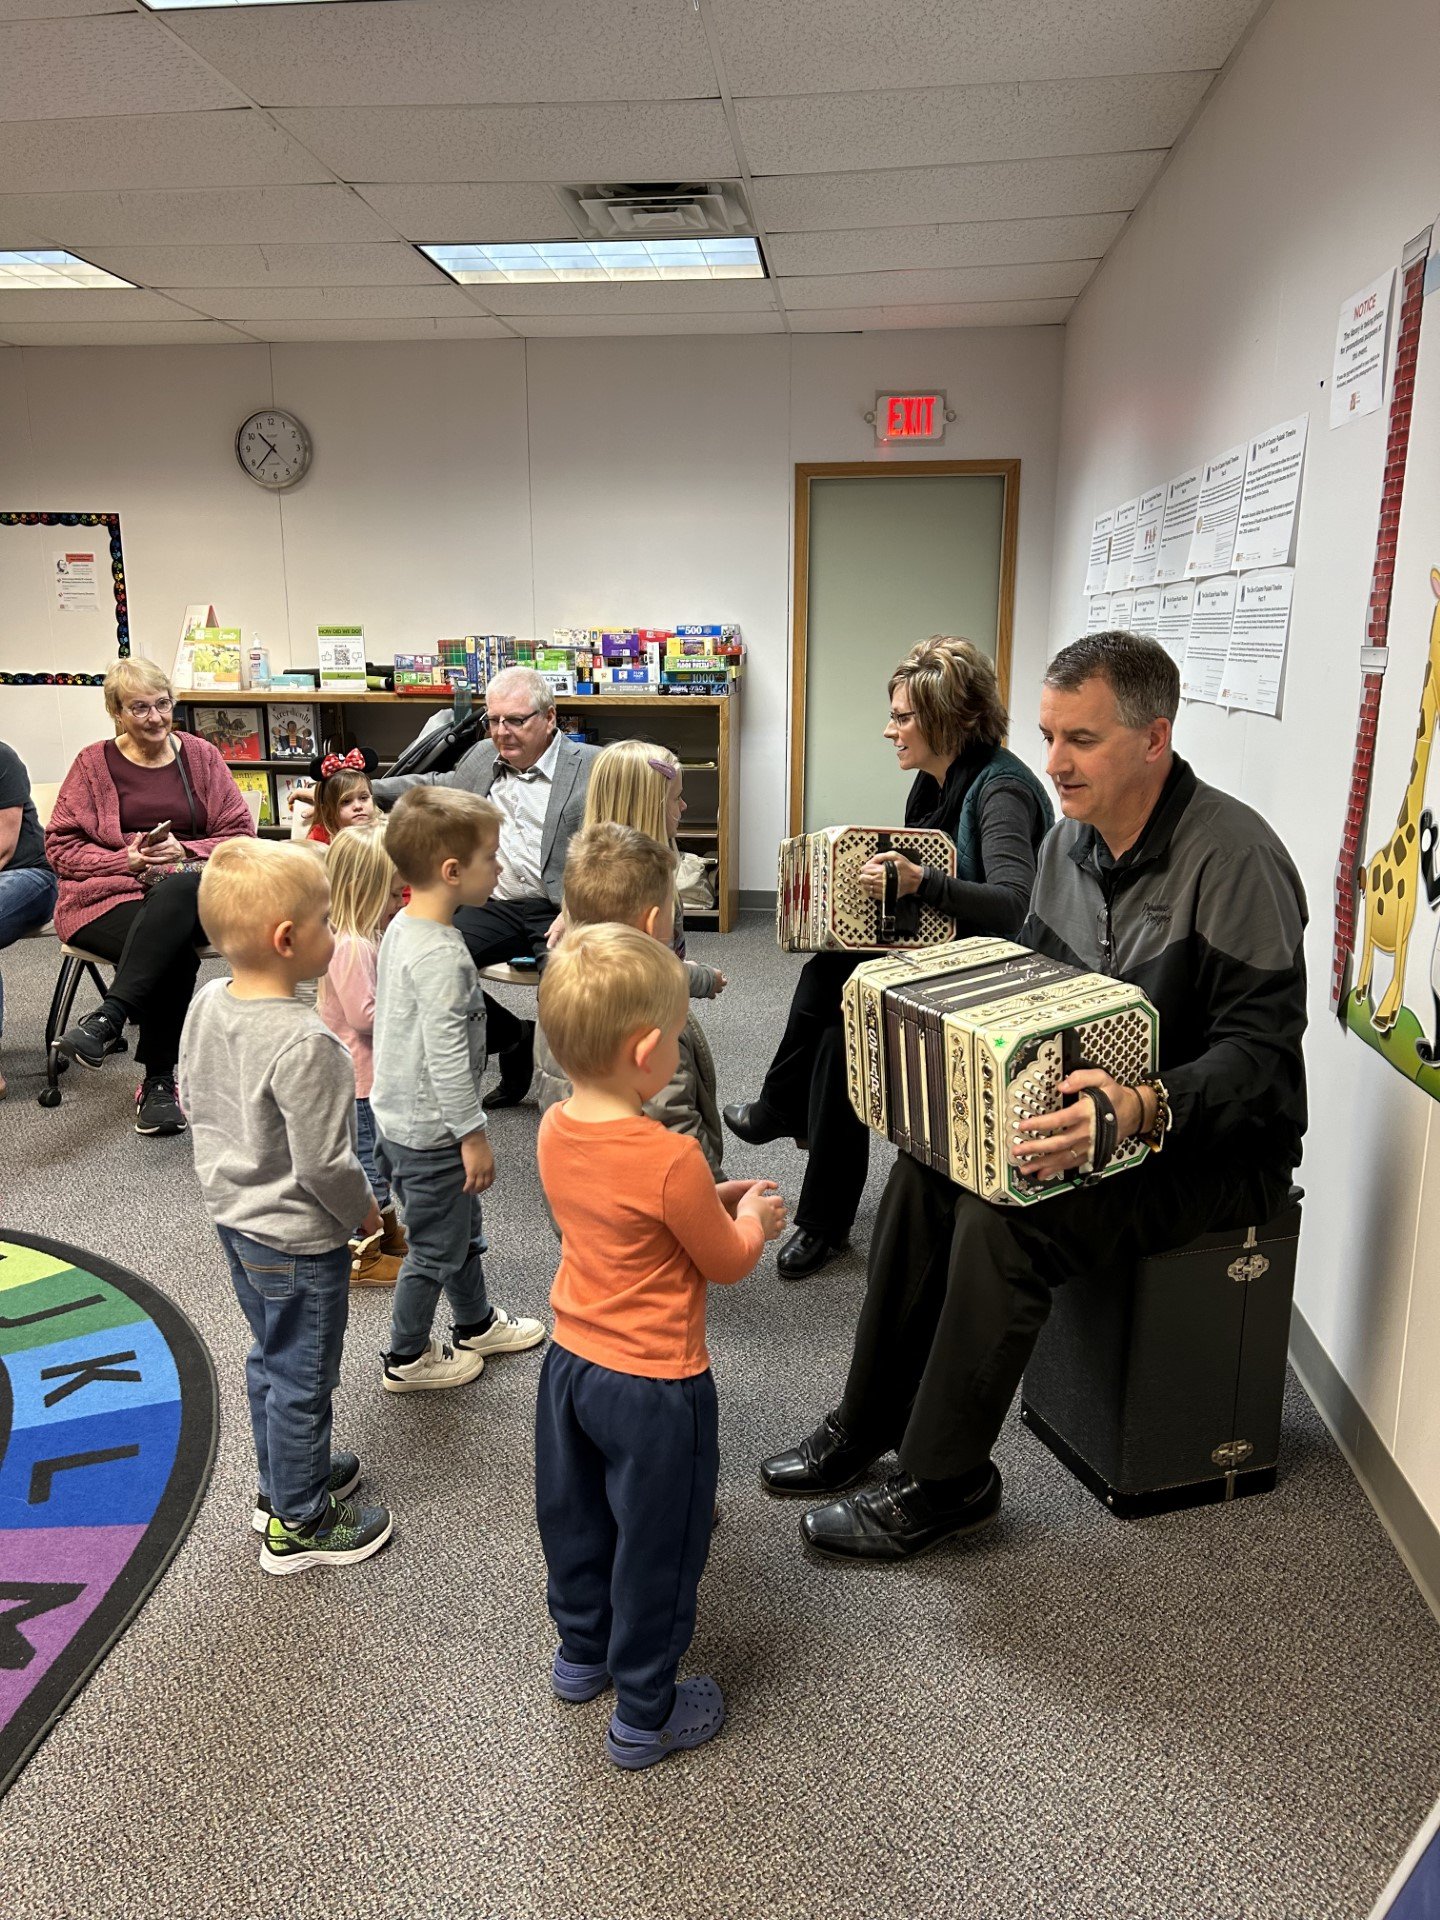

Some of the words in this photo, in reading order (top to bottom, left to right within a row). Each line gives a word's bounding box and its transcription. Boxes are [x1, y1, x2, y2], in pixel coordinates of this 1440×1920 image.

[1353, 292, 1377, 321] NOTICE
[886, 396, 937, 436] EXIT
[256, 422, 263, 430] 11
[267, 418, 275, 426] 12
[248, 432, 256, 441] 10
[291, 430, 297, 439] 2
[245, 445, 251, 453] 9
[296, 444, 301, 452] 3
[251, 459, 256, 467] 8
[260, 468, 266, 476] 7
[273, 471, 278, 479] 6
[285, 467, 291, 475] 5
[684, 625, 703, 635] 500
[692, 673, 715, 683] 1000
[0, 1292, 107, 1329] J
[40, 1349, 142, 1409] K
[27, 1443, 140, 1505] L
